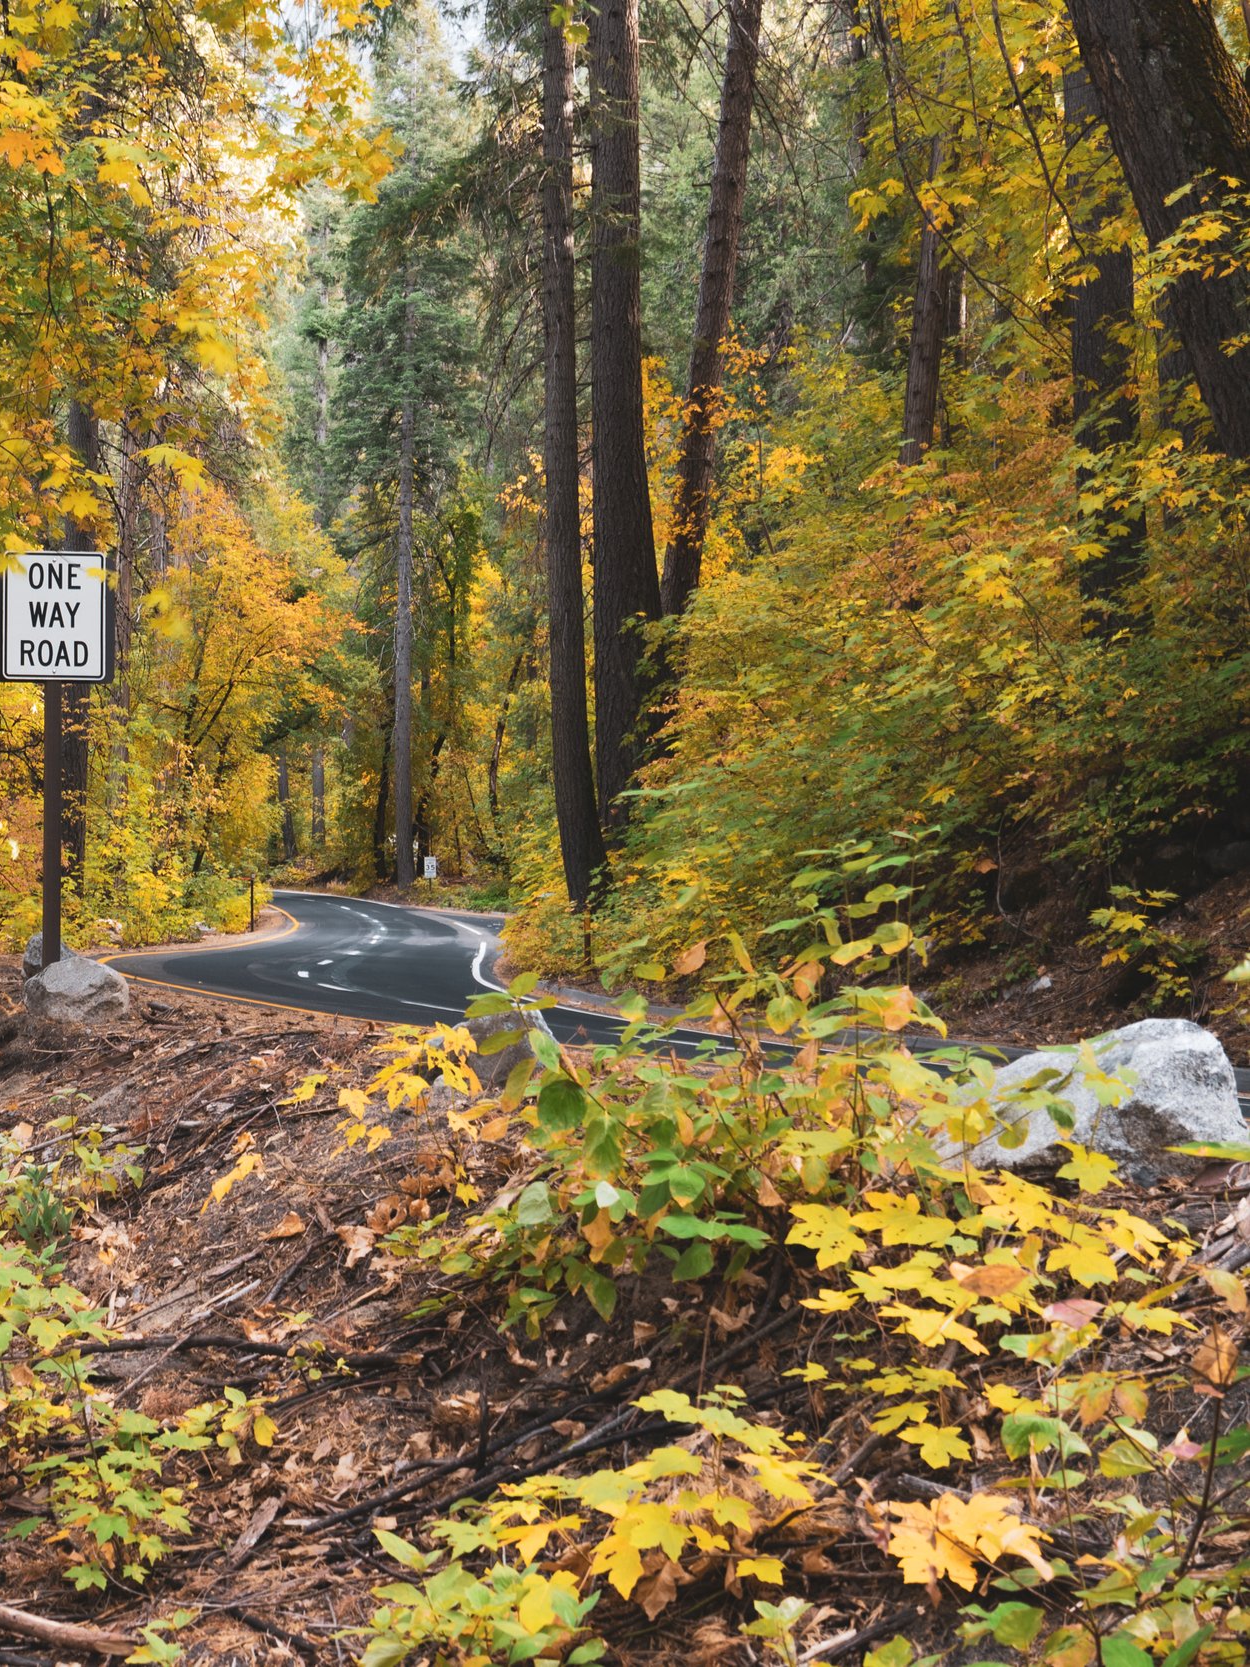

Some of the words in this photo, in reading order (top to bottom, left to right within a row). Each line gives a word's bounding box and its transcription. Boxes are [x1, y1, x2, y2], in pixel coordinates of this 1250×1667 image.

[29, 563, 81, 589] ONE
[29, 602, 80, 628] WAY
[20, 640, 88, 667] ROAD
